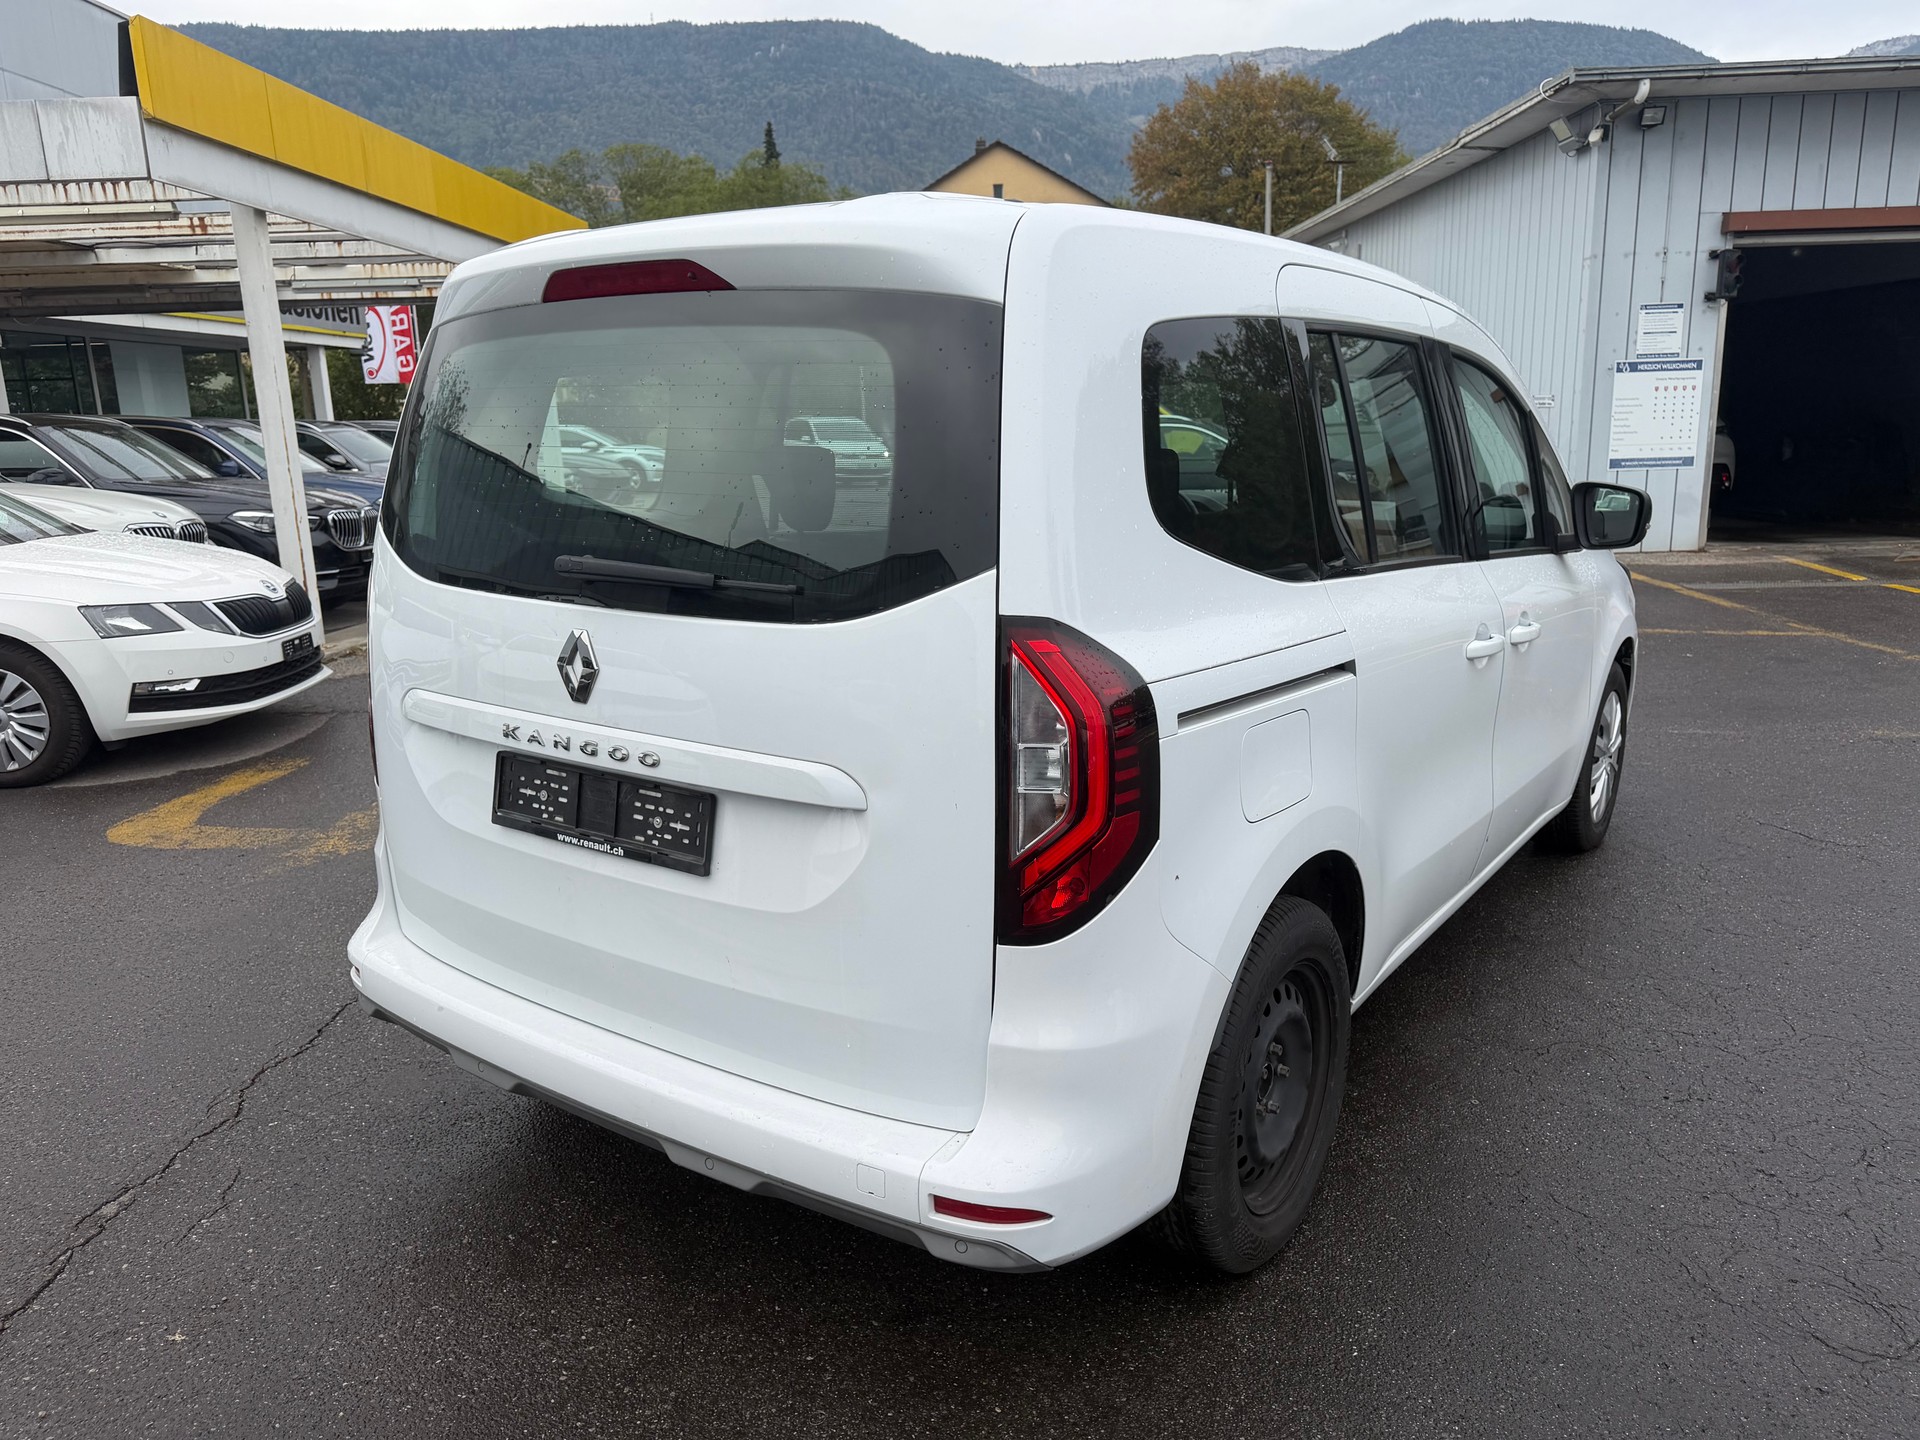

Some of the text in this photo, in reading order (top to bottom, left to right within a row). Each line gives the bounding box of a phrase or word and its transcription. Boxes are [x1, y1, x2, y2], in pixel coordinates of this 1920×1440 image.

[1661, 362, 1697, 370] WILLKOMMEN
[502, 723, 661, 768] KANGOO
[556, 832, 624, 857] www.renault.ch
